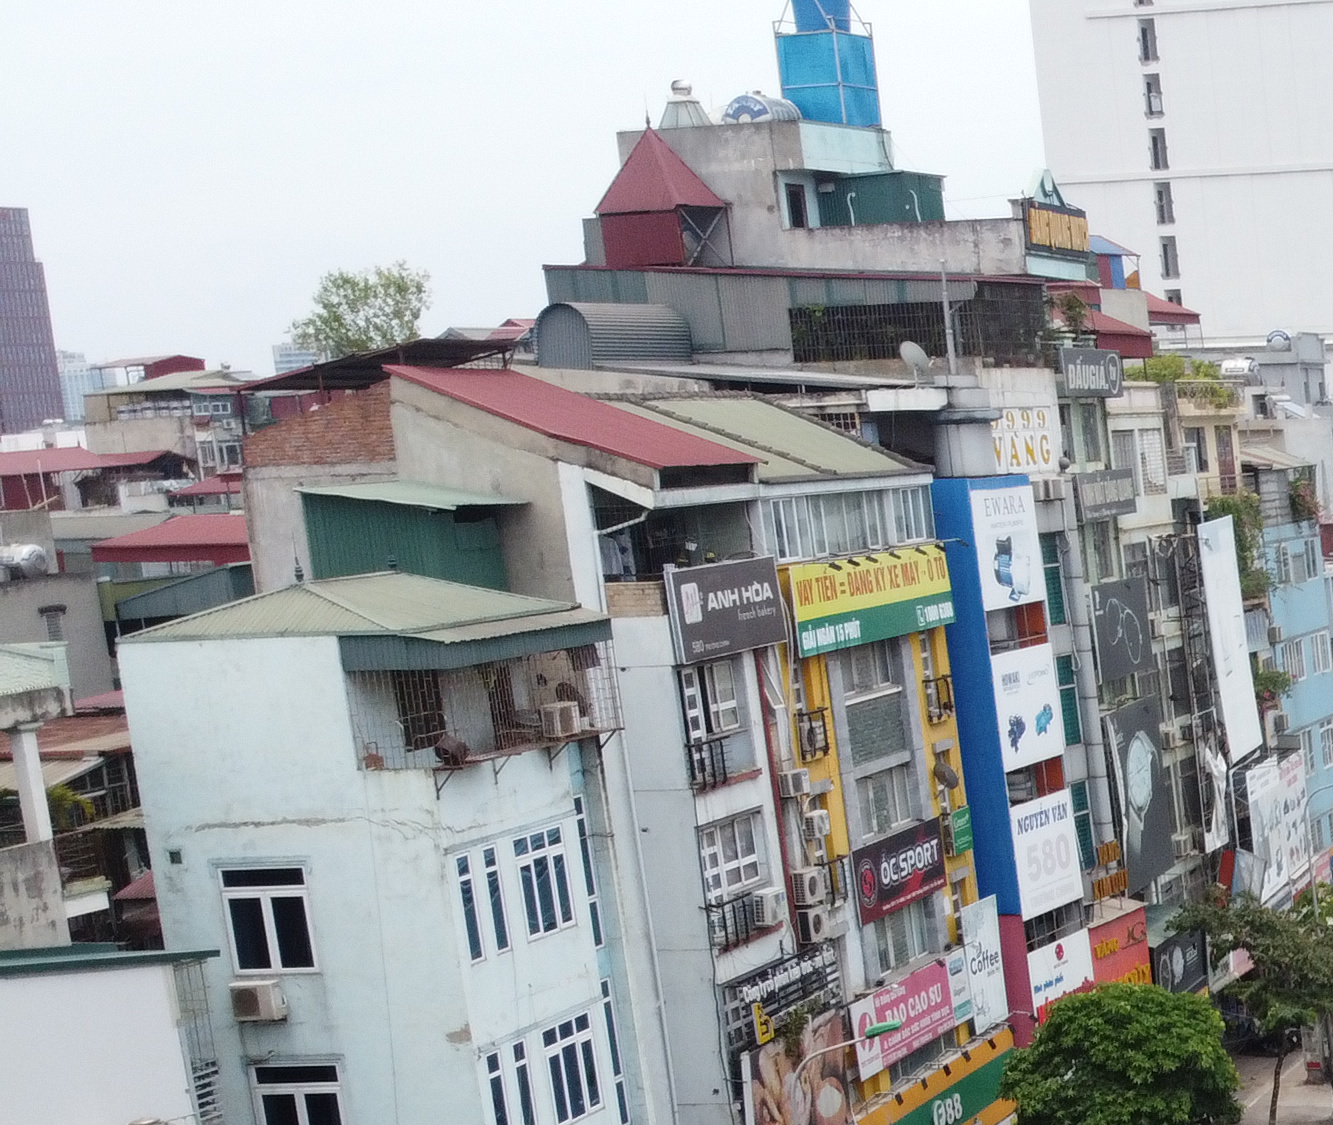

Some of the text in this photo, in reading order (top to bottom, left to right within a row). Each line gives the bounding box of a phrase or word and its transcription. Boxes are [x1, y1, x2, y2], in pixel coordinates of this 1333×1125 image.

[983, 494, 1026, 518] EWARA
[887, 567, 900, 588] XE
[707, 581, 774, 612] ANH HÒA
[899, 838, 938, 878] SPORT
[1026, 832, 1071, 882] 580
[970, 950, 1000, 976] Coffee
[908, 994, 928, 1018] CAO
[928, 983, 943, 1006] SU
